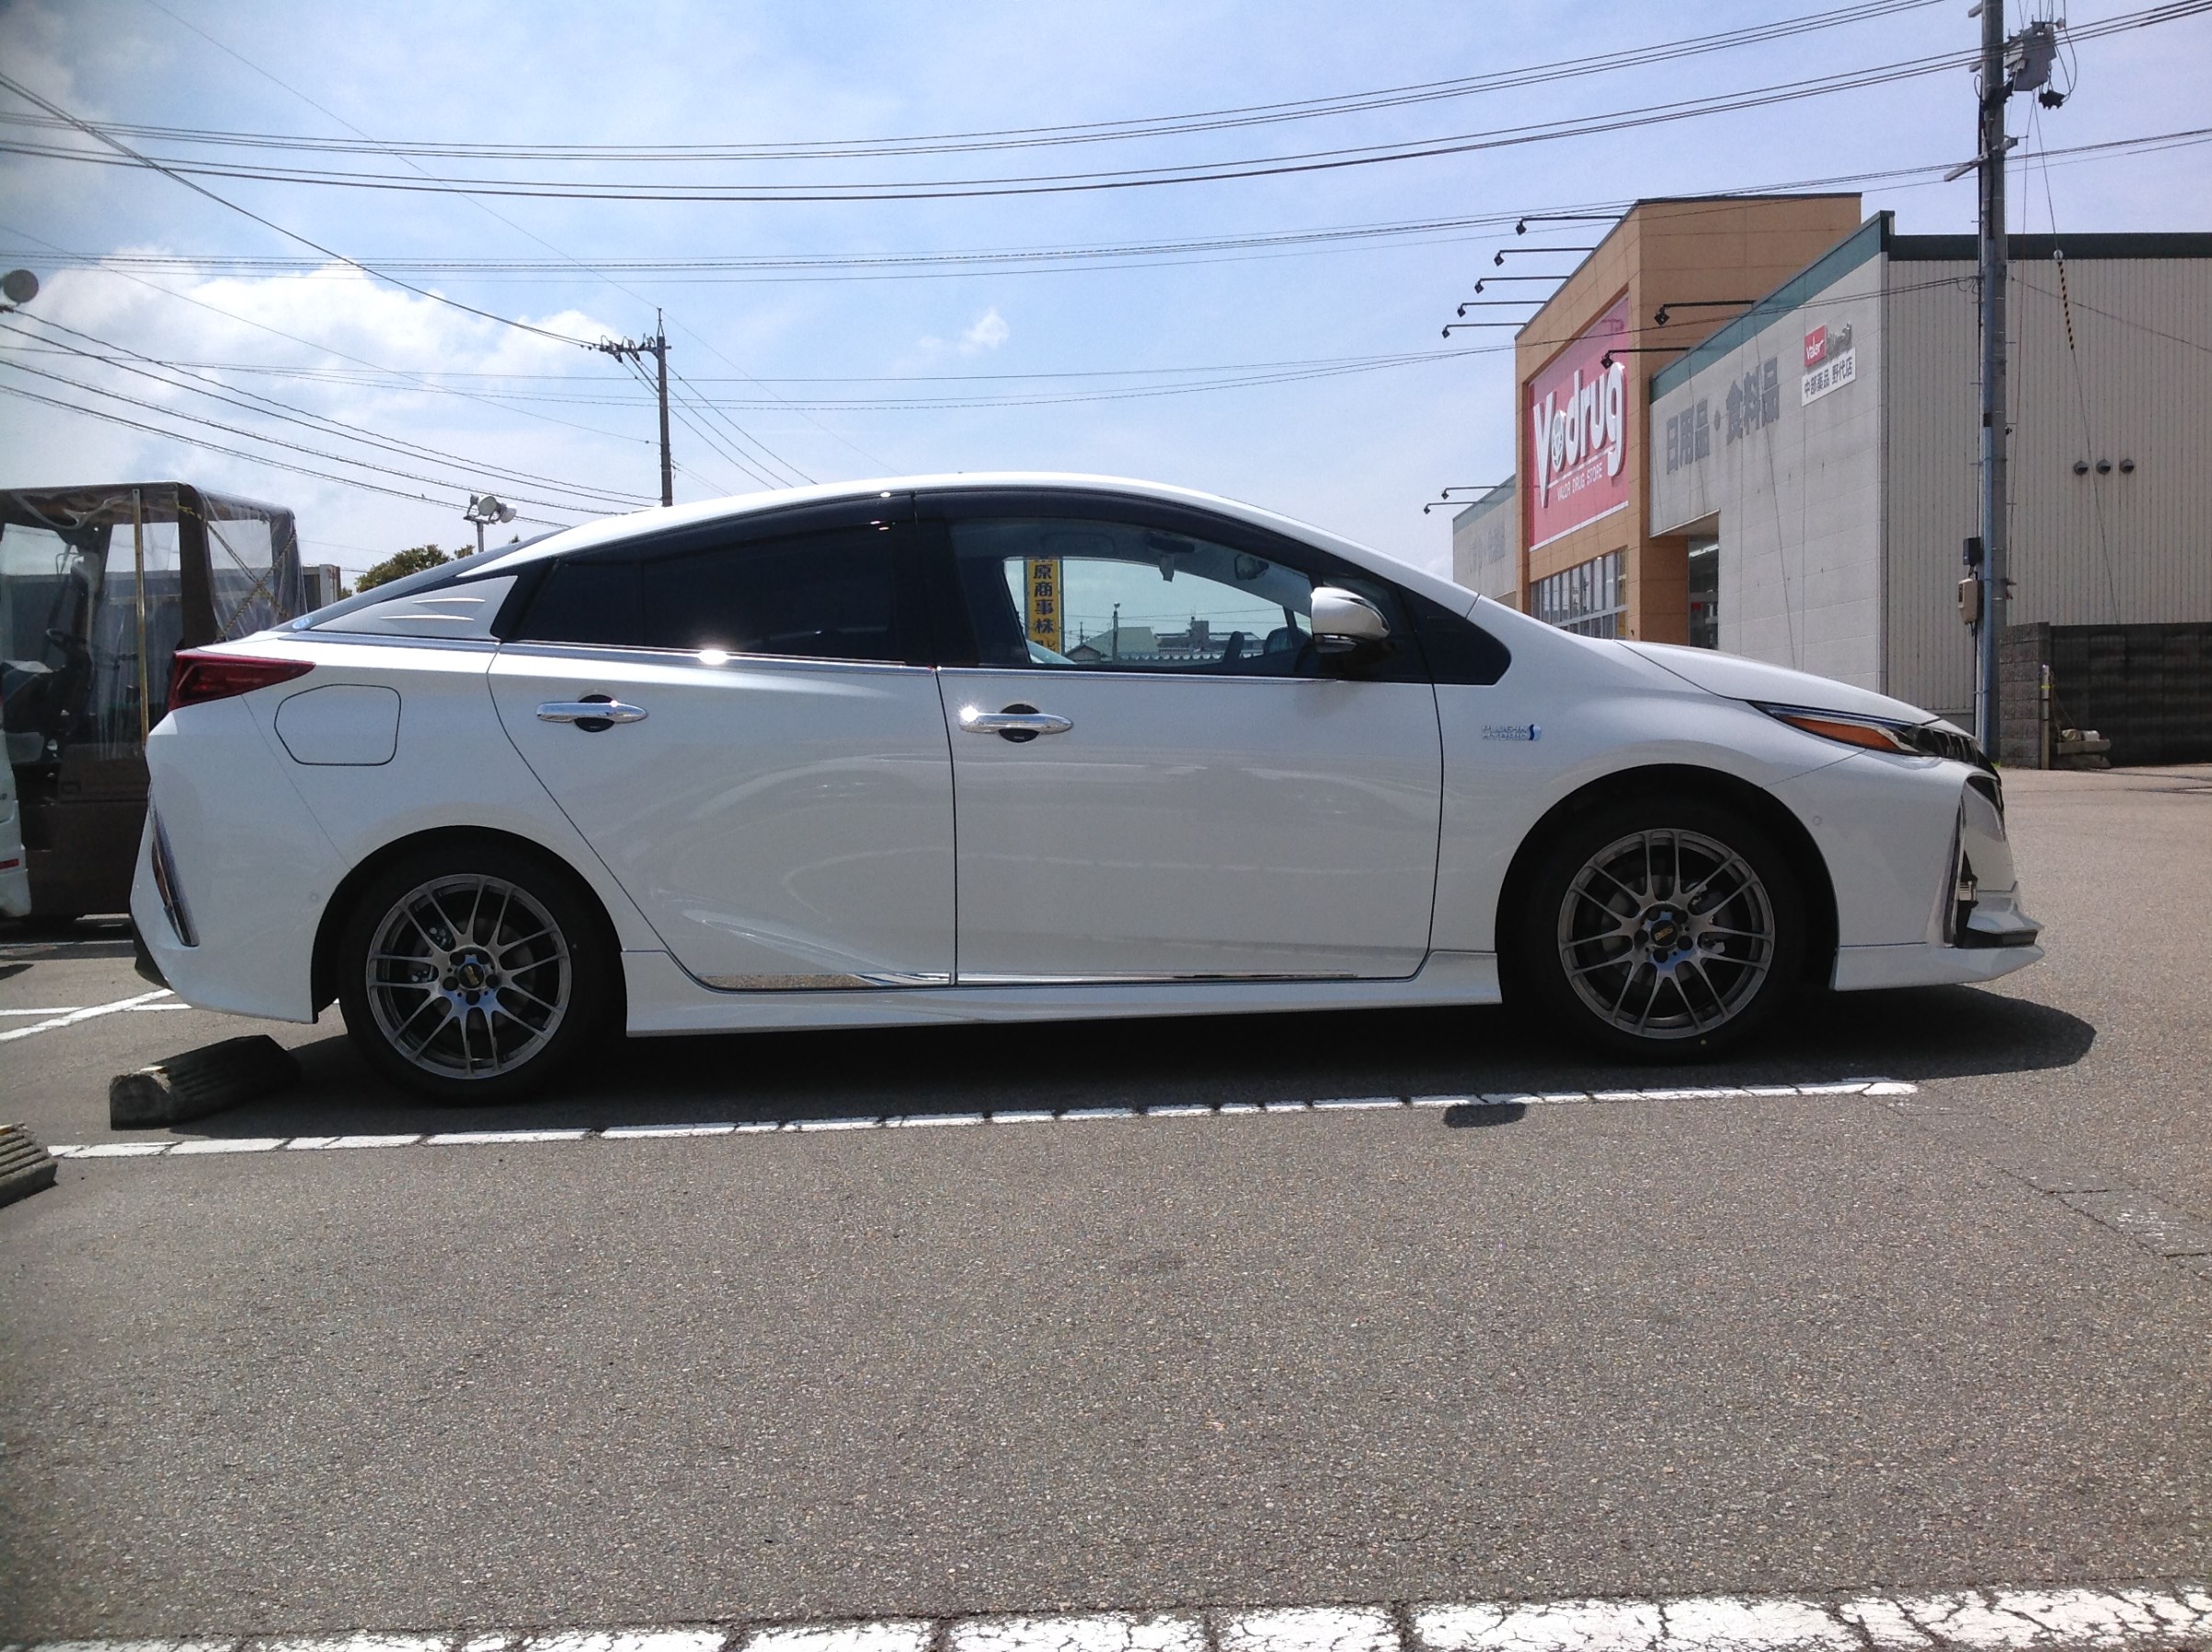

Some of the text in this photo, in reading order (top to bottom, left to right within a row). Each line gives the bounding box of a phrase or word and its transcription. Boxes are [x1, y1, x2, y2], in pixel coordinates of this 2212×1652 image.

[1572, 473, 1586, 494] DRUG
[1587, 462, 1603, 486] STORE
[1033, 559, 1055, 634] 原商事株
